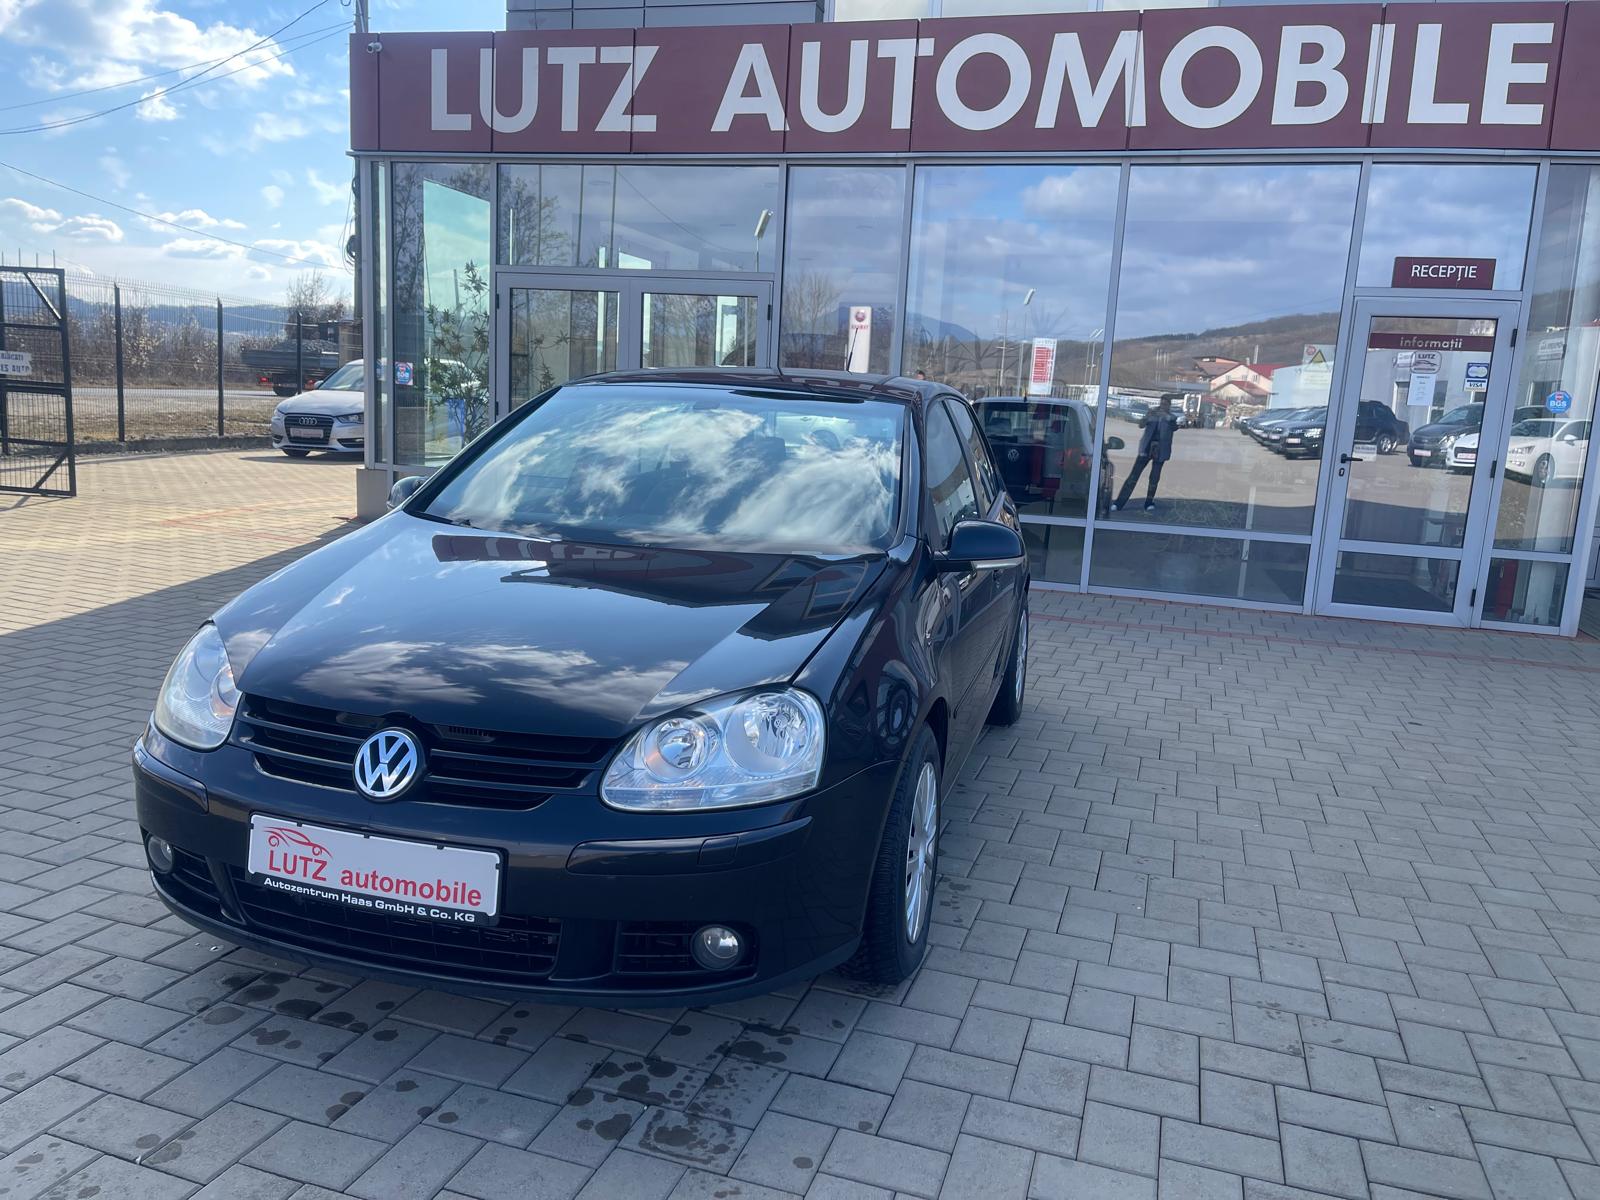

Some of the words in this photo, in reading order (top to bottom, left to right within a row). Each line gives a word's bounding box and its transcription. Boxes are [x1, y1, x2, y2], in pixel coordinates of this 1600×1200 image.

[431, 46, 660, 133] LUTZ
[710, 22, 1556, 133] AUTOMOBILE
[263, 877, 339, 901] Autozentrum
[341, 893, 373, 908] Haas
[375, 900, 414, 915] GmbH
[416, 906, 427, 916] &
[430, 908, 452, 920] Co.
[454, 911, 475, 923] KG
[268, 849, 328, 882] LUTZ
[340, 867, 482, 907] automobile
